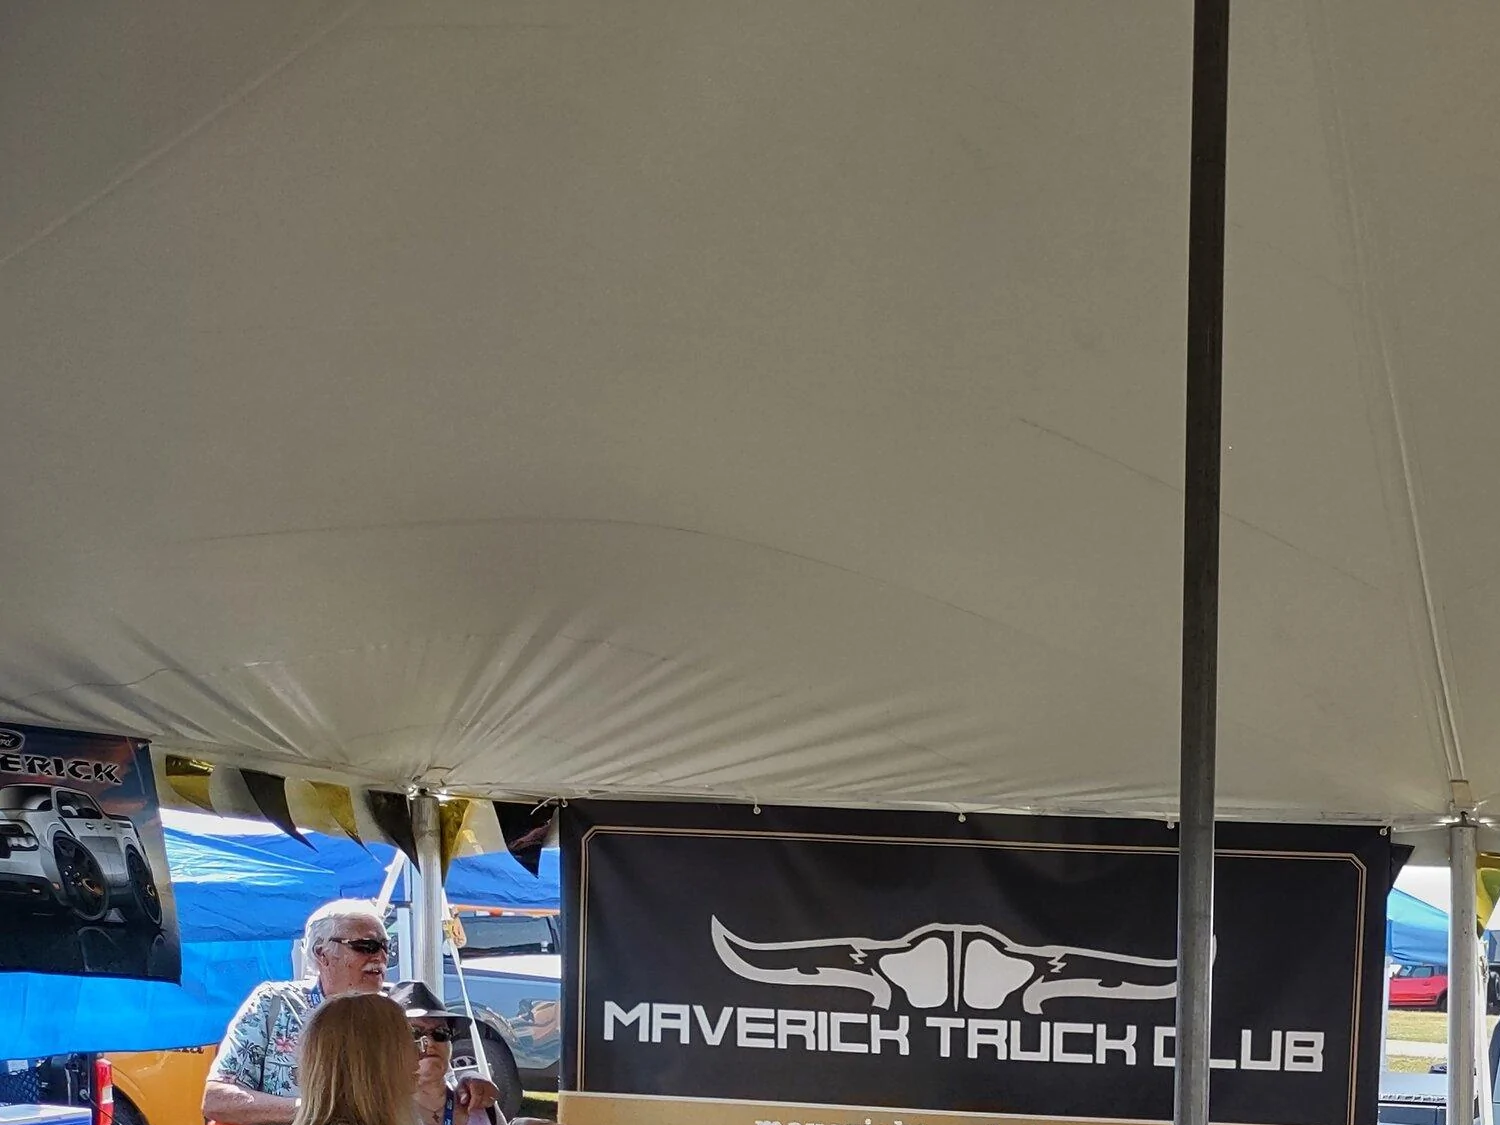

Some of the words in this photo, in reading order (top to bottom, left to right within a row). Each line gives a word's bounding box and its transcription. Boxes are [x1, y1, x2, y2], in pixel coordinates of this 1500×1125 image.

[603, 1001, 909, 1056] MAVERICK
[926, 1016, 1137, 1066] TRUCK
[1153, 1026, 1325, 1073] CLUB
